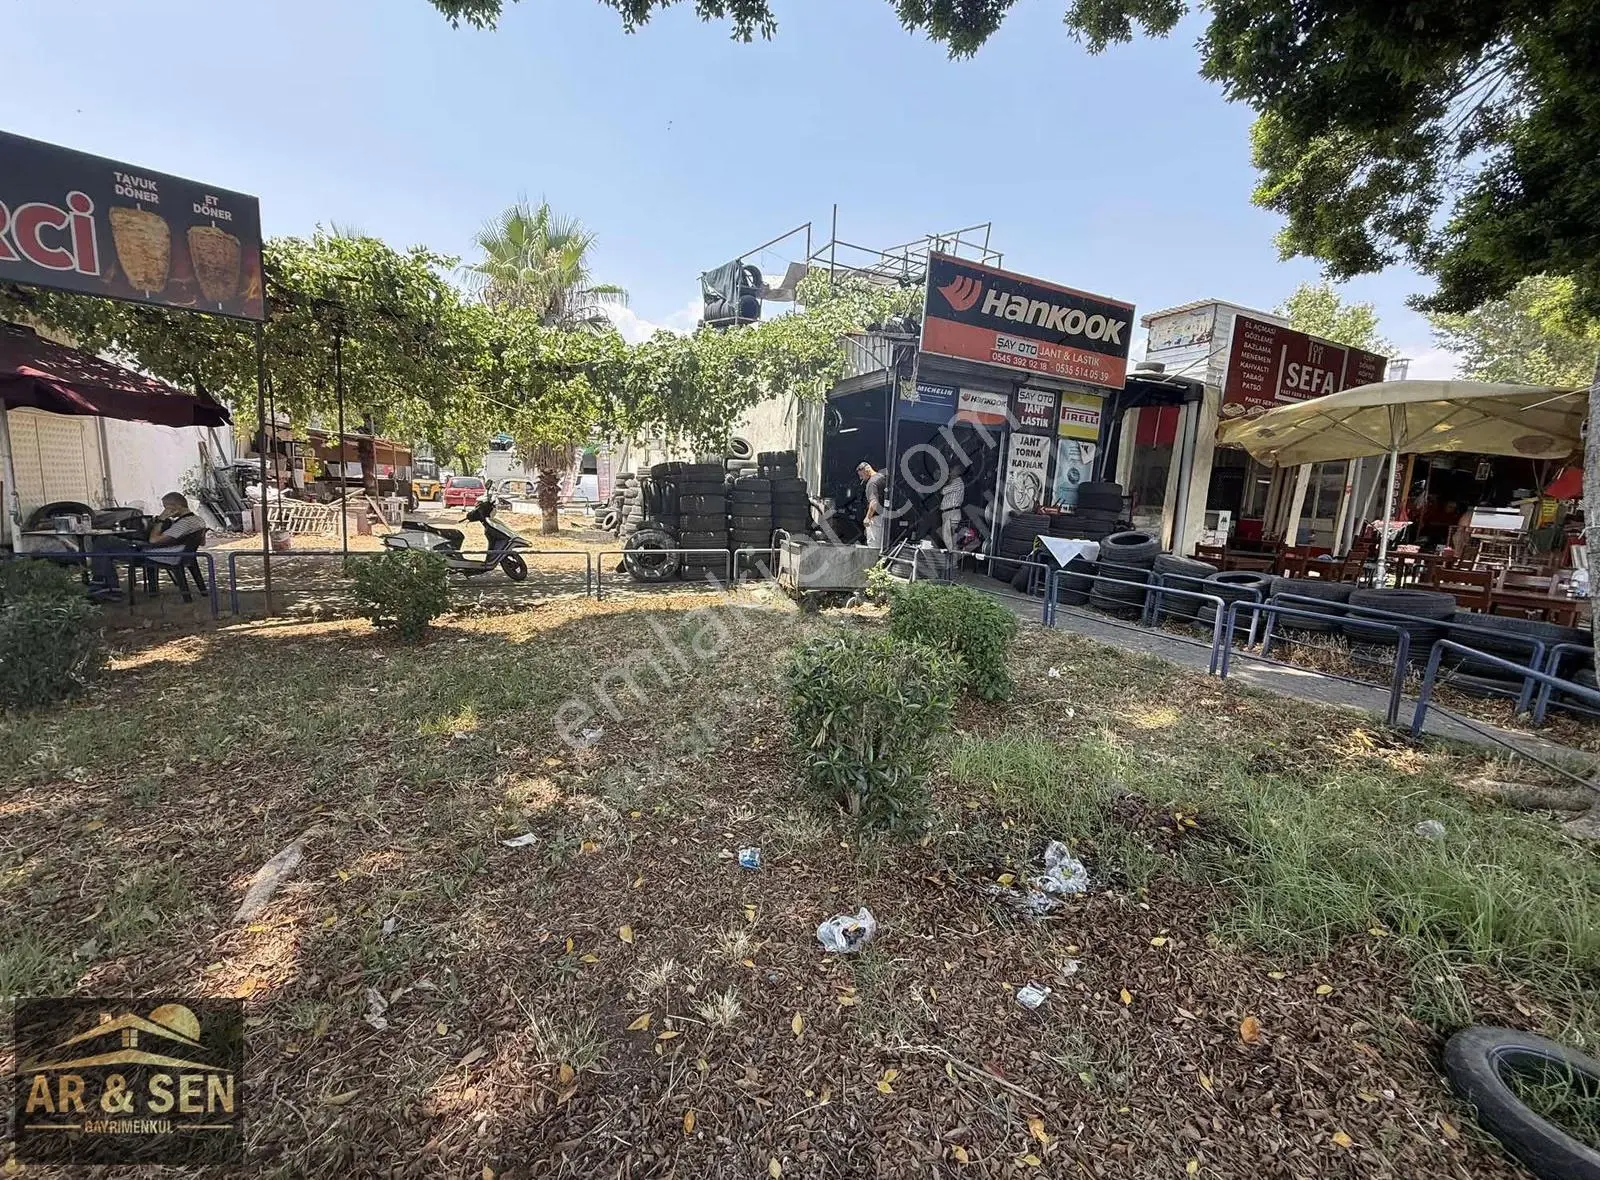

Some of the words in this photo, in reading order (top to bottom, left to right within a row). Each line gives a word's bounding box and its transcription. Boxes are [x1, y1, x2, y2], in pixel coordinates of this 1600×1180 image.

[114, 171, 158, 192] TAVUK
[114, 184, 159, 205] DÖNER
[205, 195, 219, 206] ET
[193, 203, 232, 222] DÖNER
[981, 288, 1127, 345] Hankook
[1245, 321, 1252, 329] EL
[1244, 331, 1273, 344] GÖZLEME
[997, 337, 1016, 350] SAY
[1018, 343, 1037, 355] OTO
[1039, 347, 1062, 359] JANT
[1064, 352, 1070, 361] &
[1243, 341, 1272, 354] BAZLAMA
[1241, 351, 1272, 363] MENEMEN
[992, 352, 1011, 363] 0545
[1013, 356, 1026, 367] 392
[1028, 360, 1038, 369] 92
[1039, 362, 1048, 371] 18
[1055, 363, 1073, 375] 0535
[1075, 367, 1088, 378] 514
[1089, 370, 1098, 380] 05
[1100, 372, 1109, 381] 39
[1240, 361, 1270, 373] KAHVALTI
[1286, 362, 1334, 394] SEFA
[917, 385, 953, 396] MICHELIN
[1242, 381, 1262, 391] PATSO
[1020, 391, 1036, 401] SAY
[1037, 394, 1054, 404] OTO
[1245, 396, 1262, 405] PAKET
[1024, 403, 1045, 414] JANT
[1061, 407, 1099, 425] PIRELLI
[1020, 437, 1041, 447] JANT
[1016, 448, 1042, 458] TORNA
[1012, 459, 1043, 470] KAYNAK
